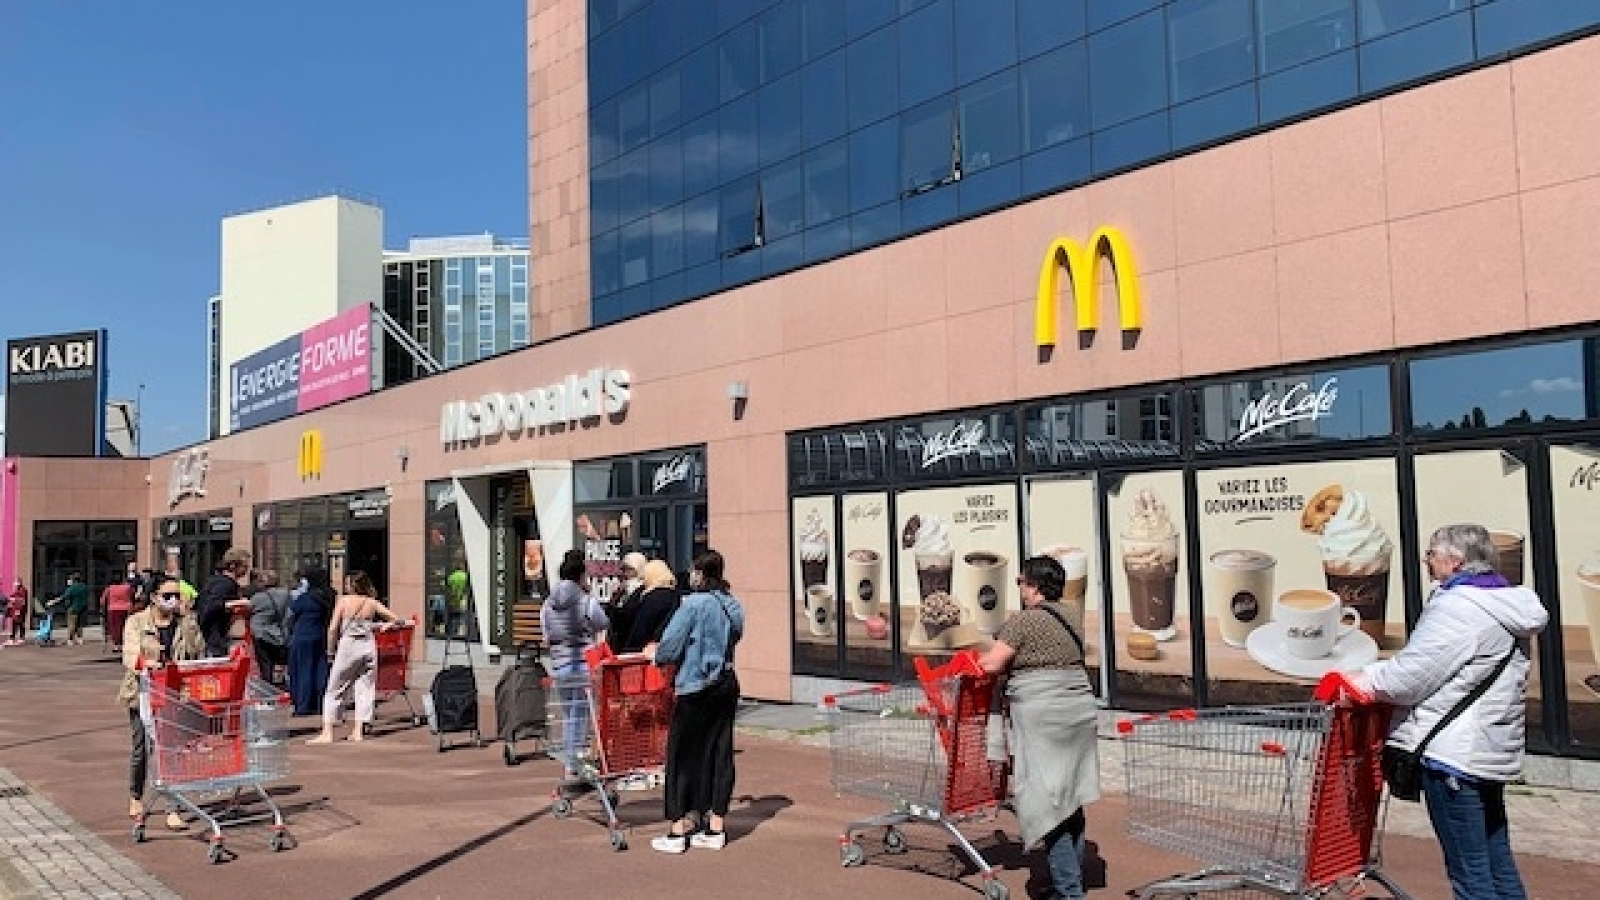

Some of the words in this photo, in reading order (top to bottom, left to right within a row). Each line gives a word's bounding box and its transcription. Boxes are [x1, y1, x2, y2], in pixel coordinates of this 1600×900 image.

[11, 339, 93, 373] KIABI
[301, 322, 368, 373] FORME
[440, 368, 630, 443] McDonald's
[1217, 479, 1260, 495] VARIEZ
[1264, 477, 1288, 493] LES
